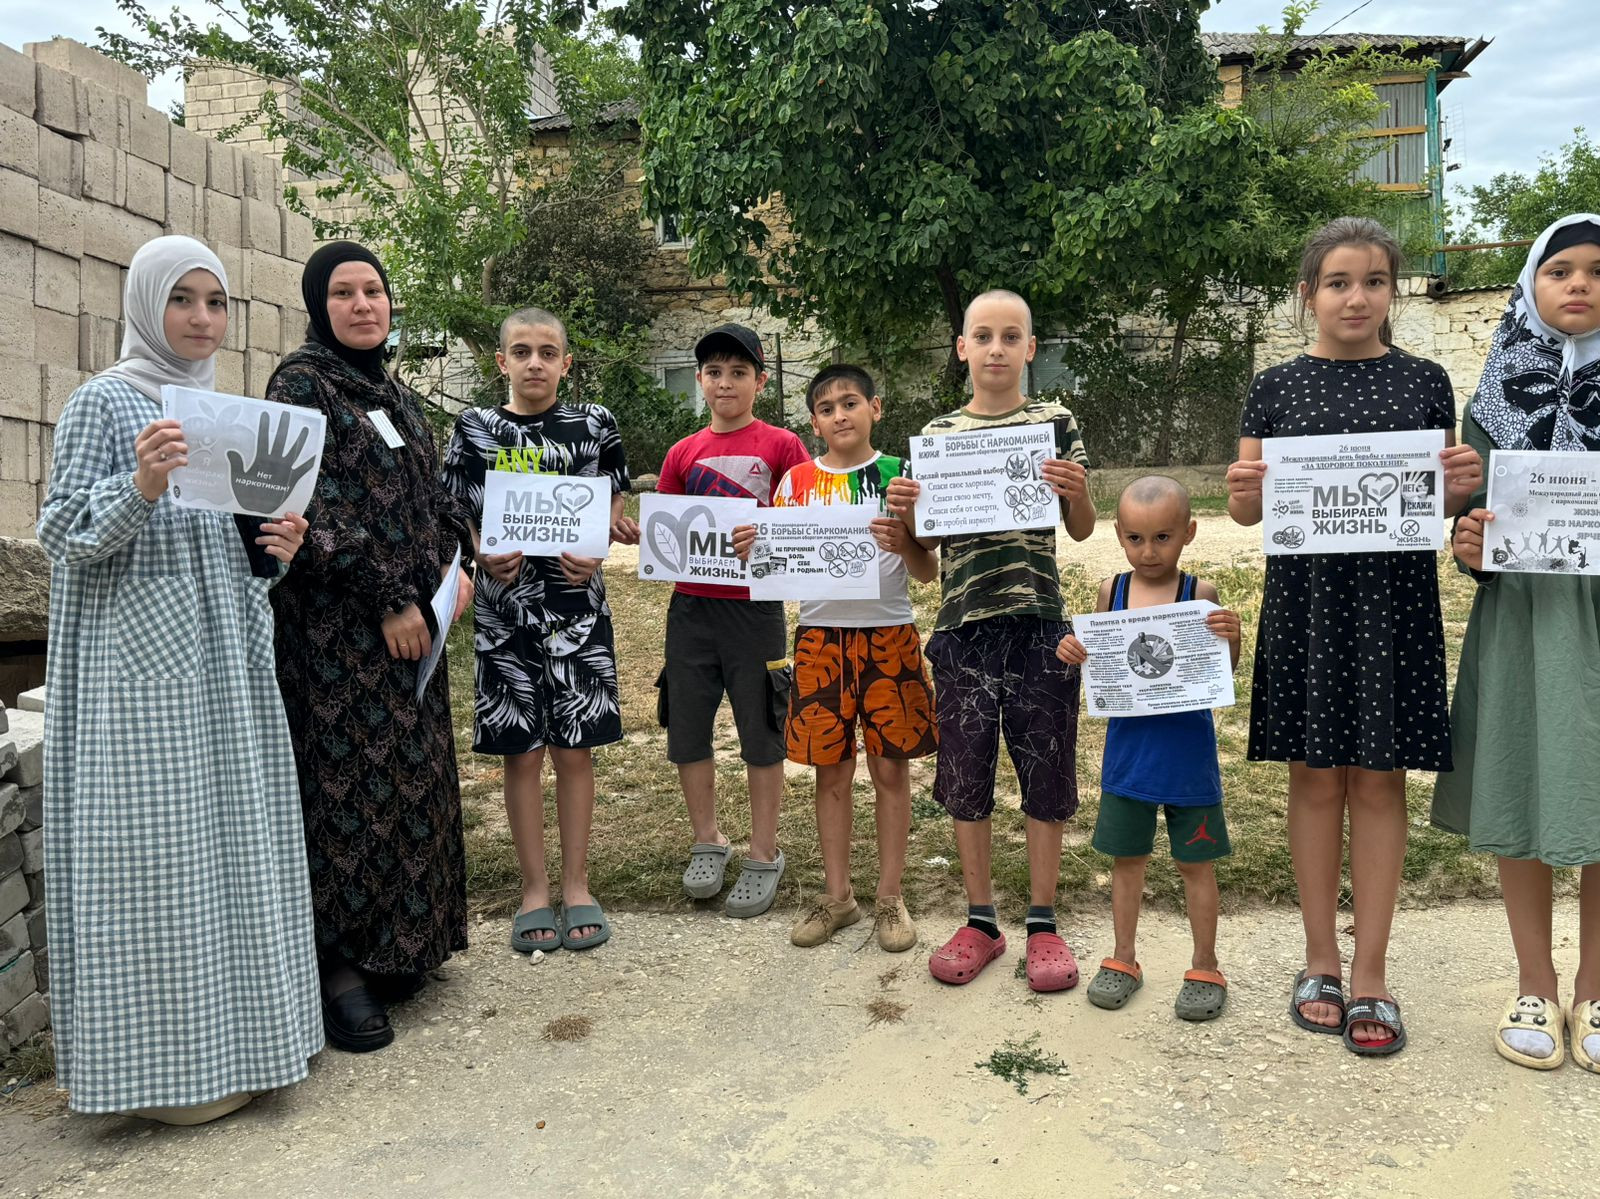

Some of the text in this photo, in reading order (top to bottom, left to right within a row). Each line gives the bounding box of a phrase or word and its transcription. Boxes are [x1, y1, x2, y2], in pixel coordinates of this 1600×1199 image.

[922, 437, 934, 447] 26
[945, 432, 1050, 451] БОРЬБЫ С НАРКОМАНИЕЙ
[1281, 454, 1337, 463] Международный
[257, 471, 273, 479] Нет
[916, 472, 939, 480] Сделай
[940, 468, 982, 480] правильный
[1530, 473, 1545, 484] 26
[1549, 476, 1587, 484] июня
[235, 478, 290, 492] наркотикам!
[928, 482, 948, 491] Спаси
[965, 480, 996, 489] здоровье,
[1403, 484, 1415, 492] НЕТ
[932, 494, 953, 502] Спаси
[973, 492, 993, 501] мечту,
[1314, 485, 1368, 508] МЫ
[1529, 490, 1581, 498] Международный
[505, 490, 563, 514] МЫ
[1407, 502, 1432, 510] СКАЖИ
[928, 507, 948, 515] Спаси
[950, 505, 964, 513] себя
[974, 504, 999, 513] смерти,
[1312, 507, 1387, 518] ВЫБИРАЕМ
[503, 514, 581, 527] ВЫБИРАЕМ
[943, 517, 967, 528] пробуй
[969, 515, 996, 526] наркоту!
[1568, 520, 1600, 528] НАРКО
[1312, 519, 1388, 535] ЖИЗНЬ
[501, 526, 579, 543] ЖИЗНЬ
[689, 557, 735, 566] ВЫБИРАЕМ
